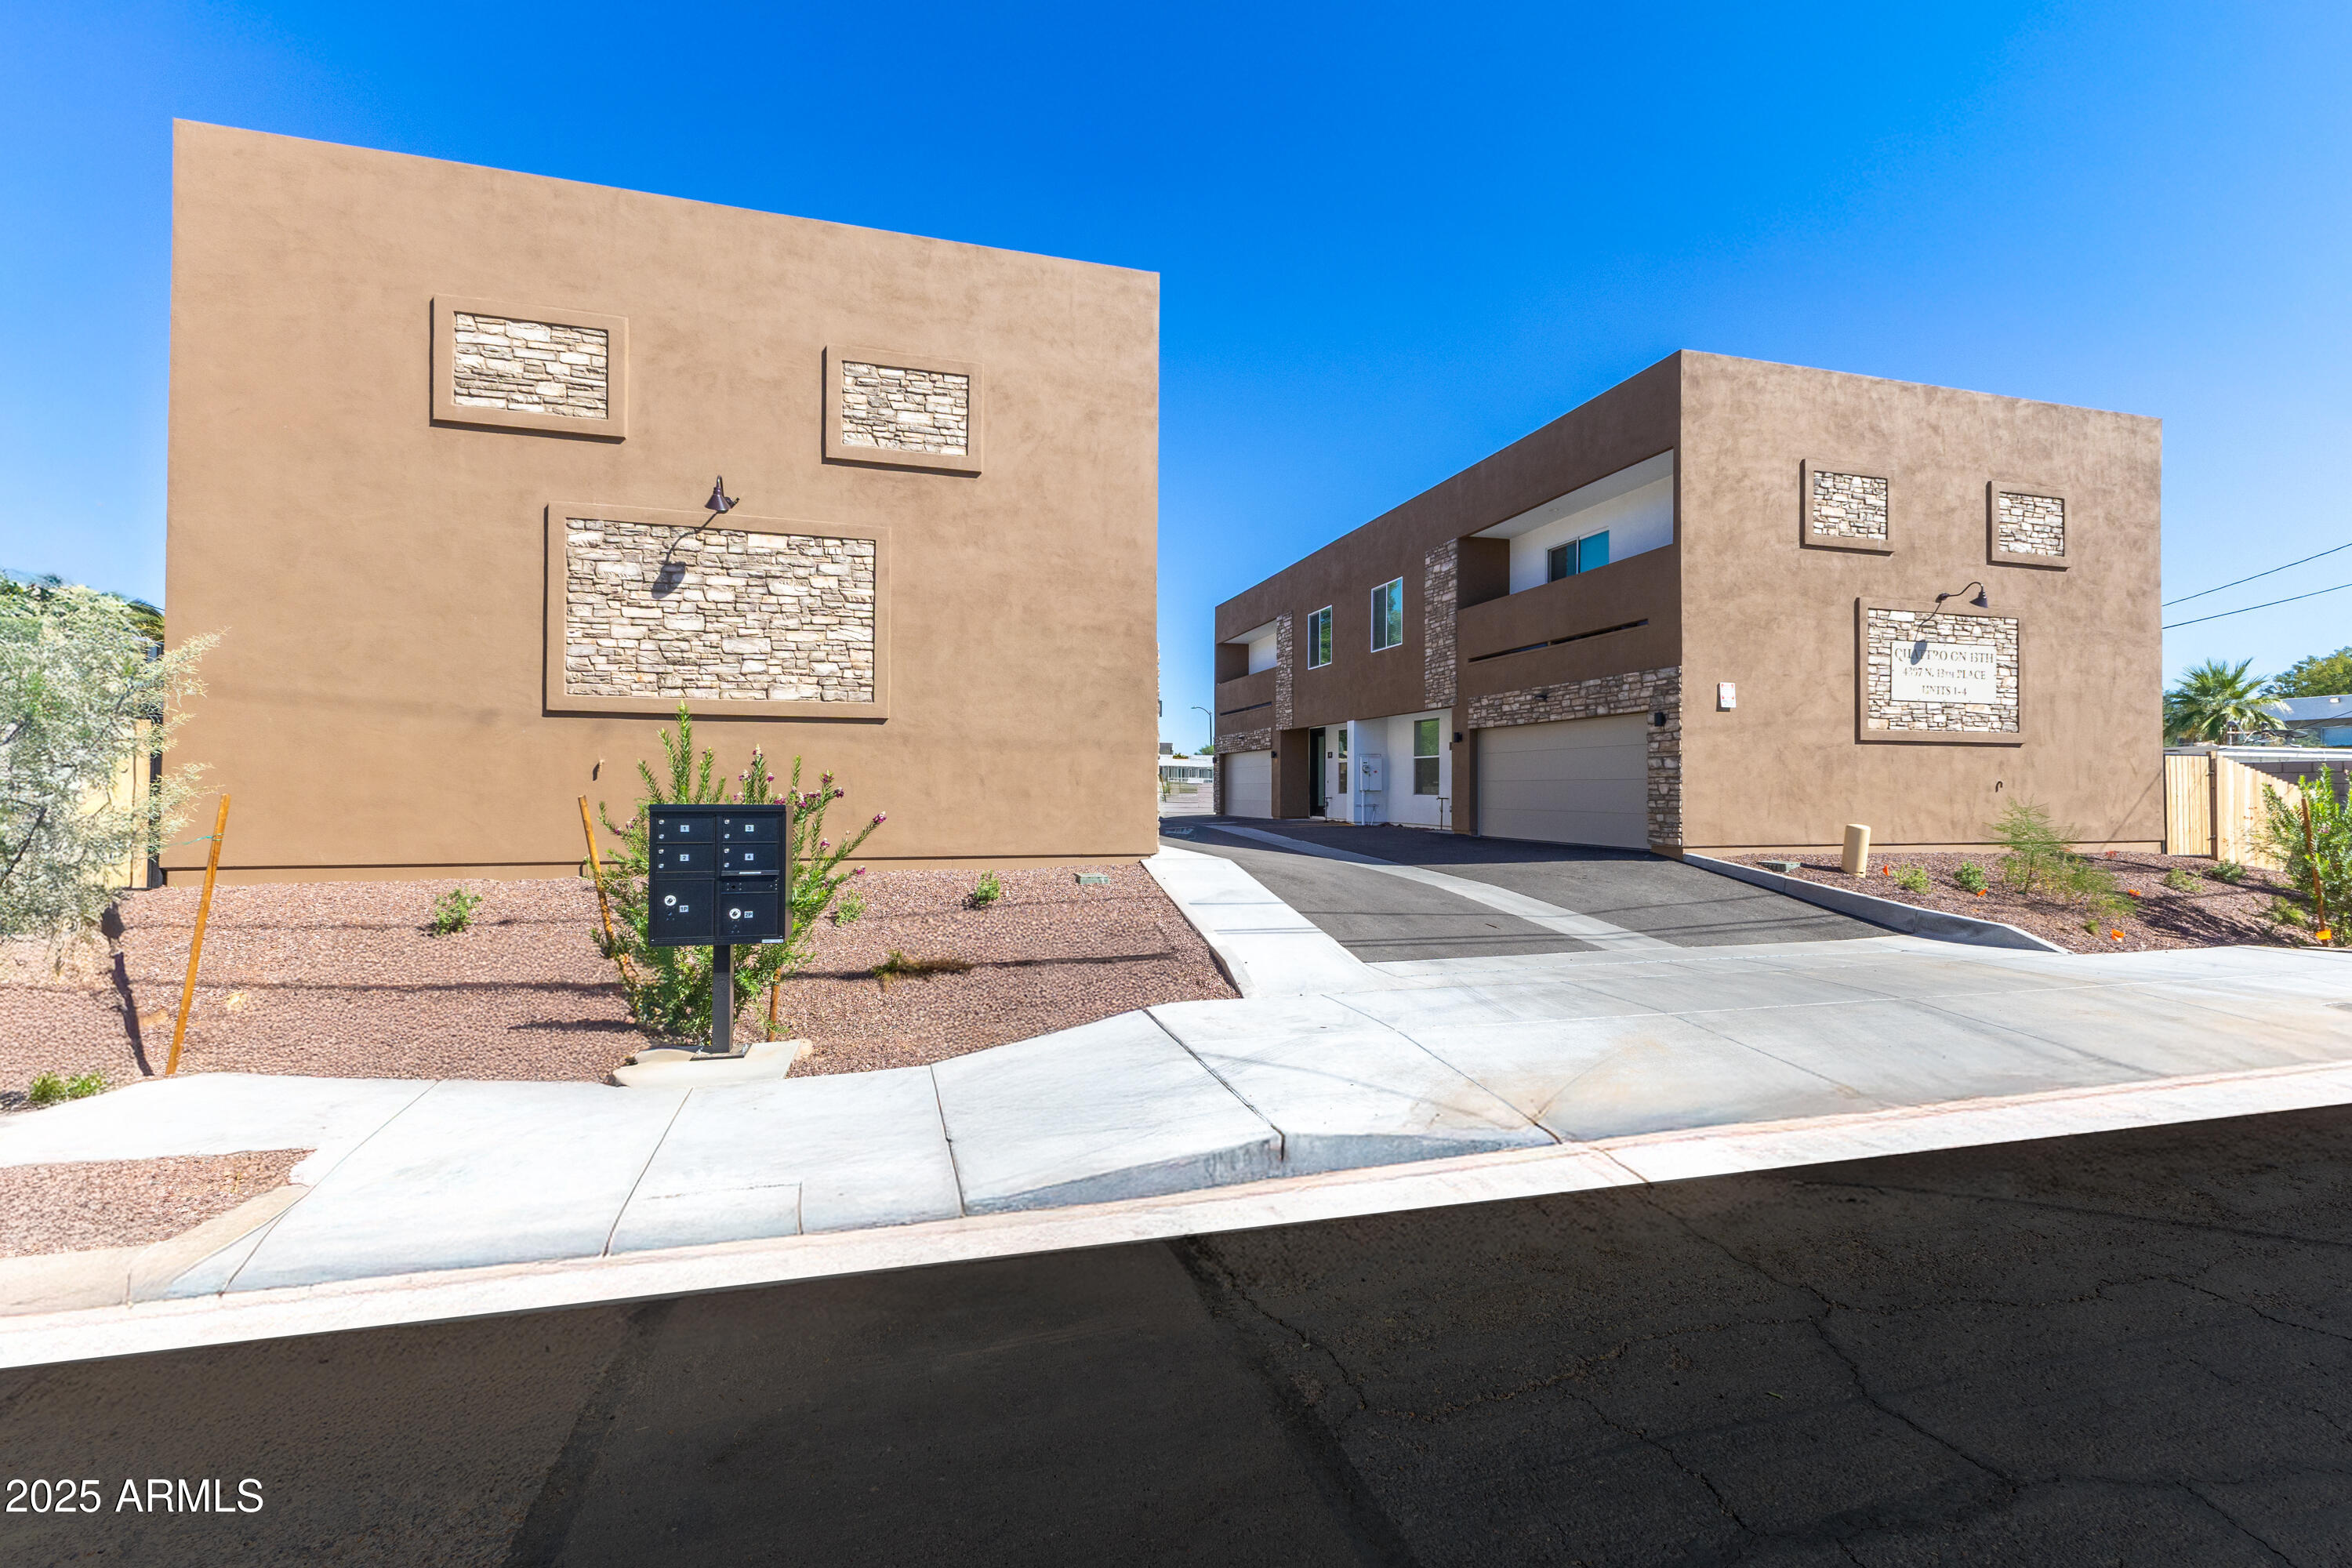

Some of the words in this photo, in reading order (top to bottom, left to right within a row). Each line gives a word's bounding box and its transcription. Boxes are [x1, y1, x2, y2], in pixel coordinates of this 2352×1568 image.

[1951, 651, 1966, 661] ON
[1970, 652, 1994, 663] 13TH
[1957, 670, 1986, 680] PLACE
[1922, 685, 1951, 695] UNITS
